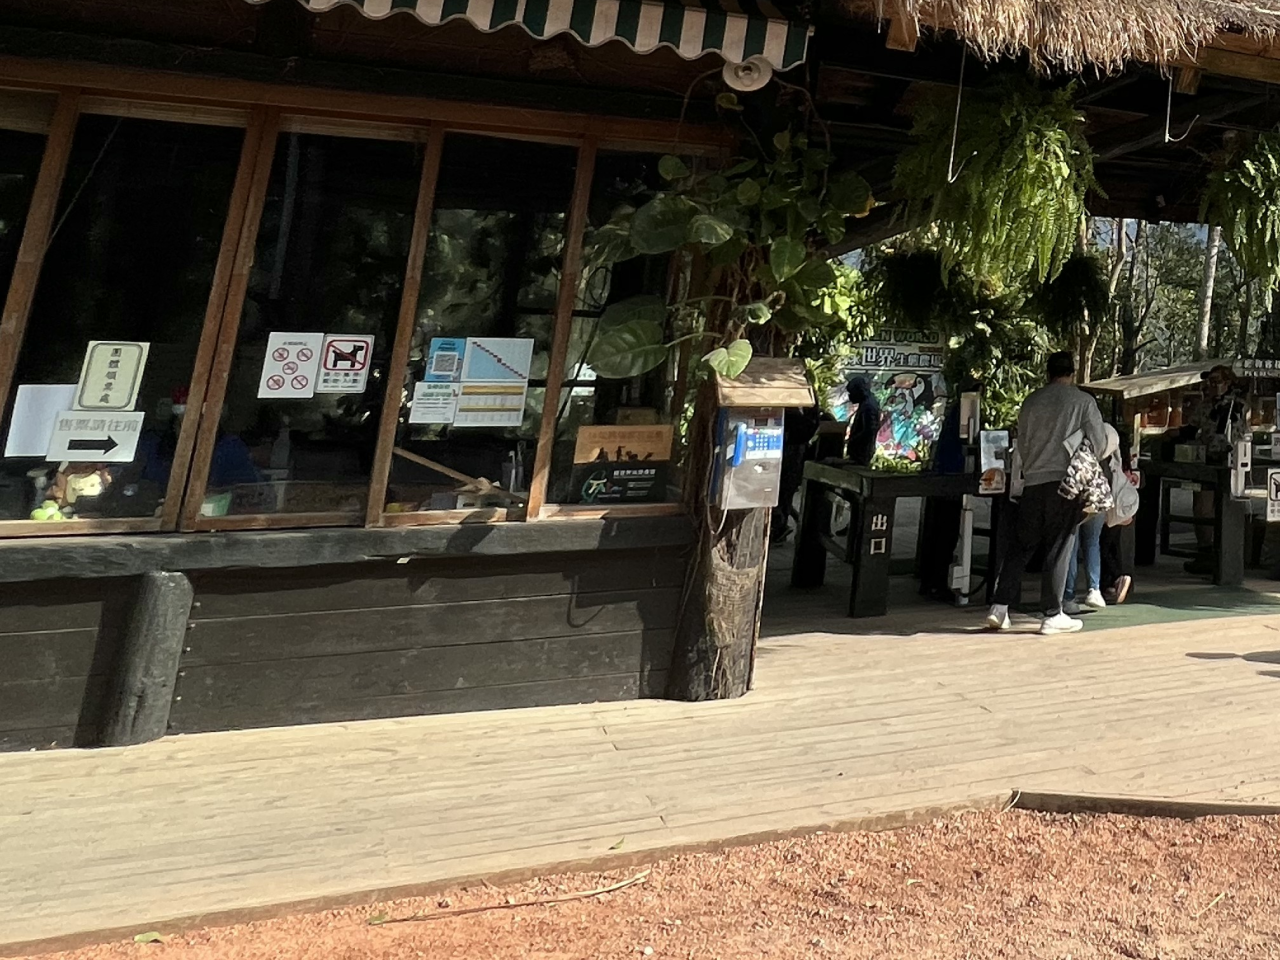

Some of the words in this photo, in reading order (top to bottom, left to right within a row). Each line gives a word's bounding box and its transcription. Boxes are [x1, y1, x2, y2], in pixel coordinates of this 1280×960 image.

[58, 417, 140, 432] 售票請往前
[870, 513, 887, 555] 出口
